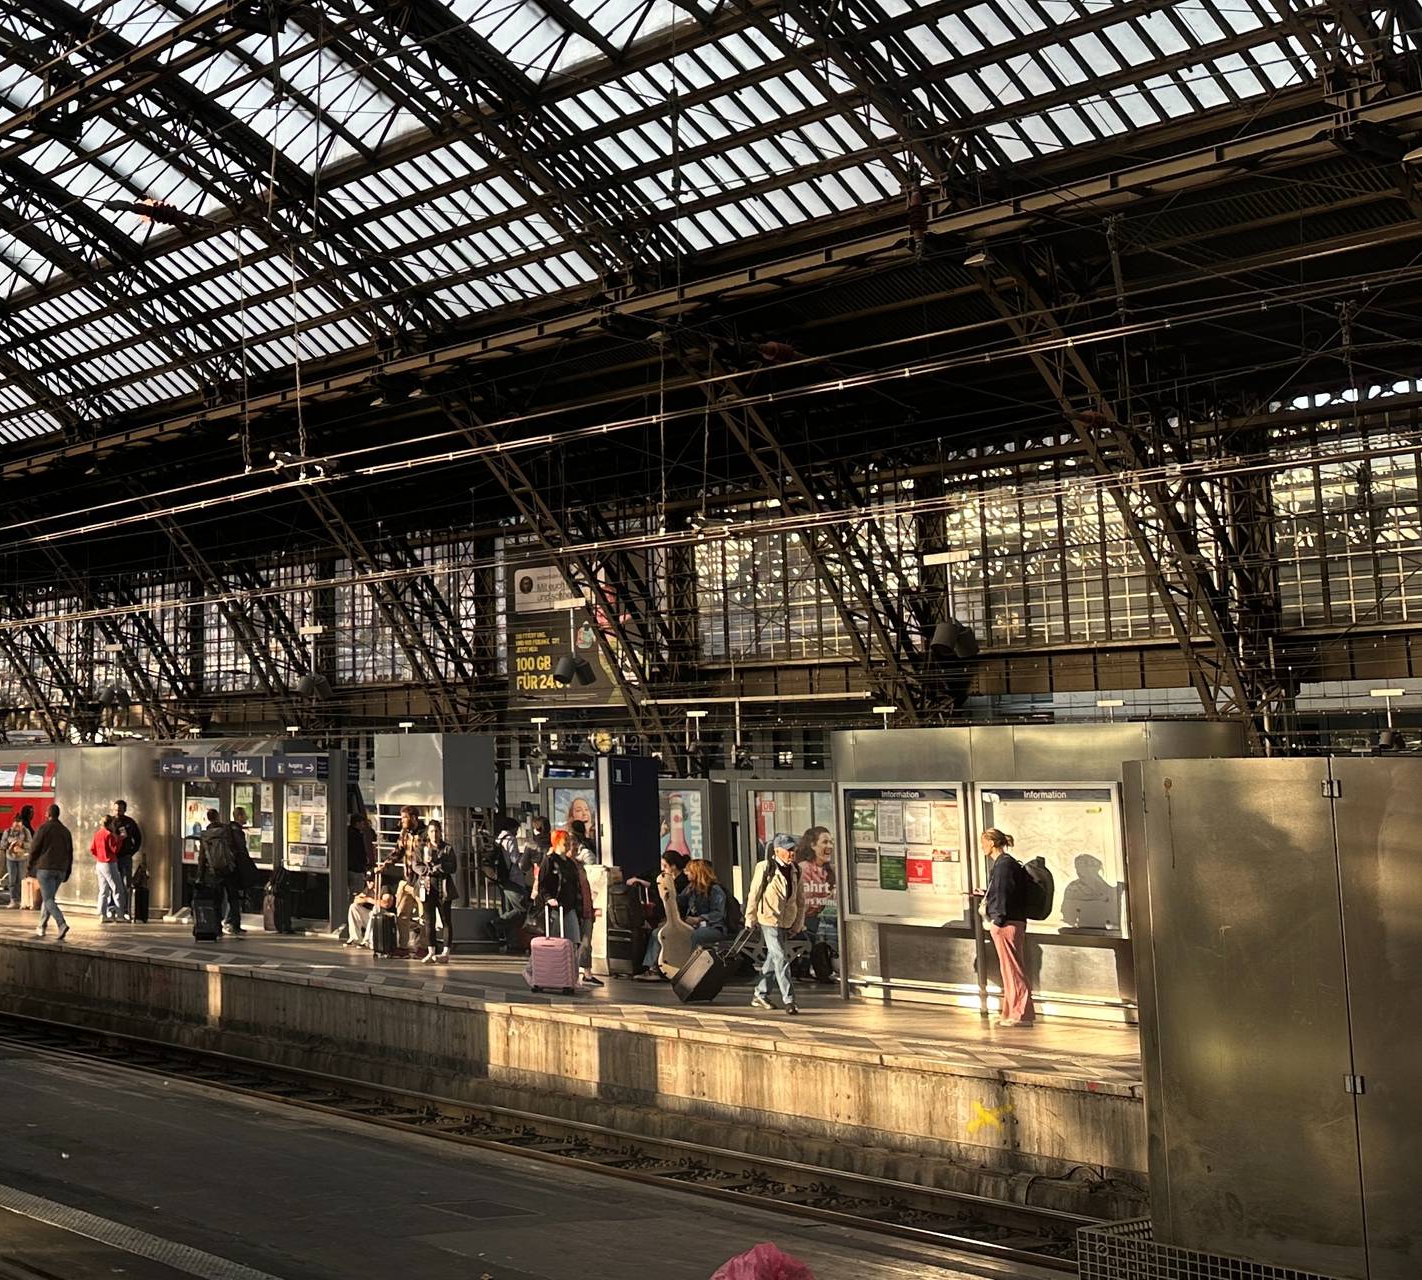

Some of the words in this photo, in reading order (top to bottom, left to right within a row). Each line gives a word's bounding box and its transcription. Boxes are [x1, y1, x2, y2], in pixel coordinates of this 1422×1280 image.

[515, 656, 535, 671] 100
[536, 655, 552, 671] GB
[516, 672, 538, 691] FÜR
[210, 759, 230, 773] Köln
[231, 759, 249, 773] Hbf
[881, 790, 920, 799] Information
[1023, 790, 1068, 800] Information
[762, 801, 775, 812] DB
